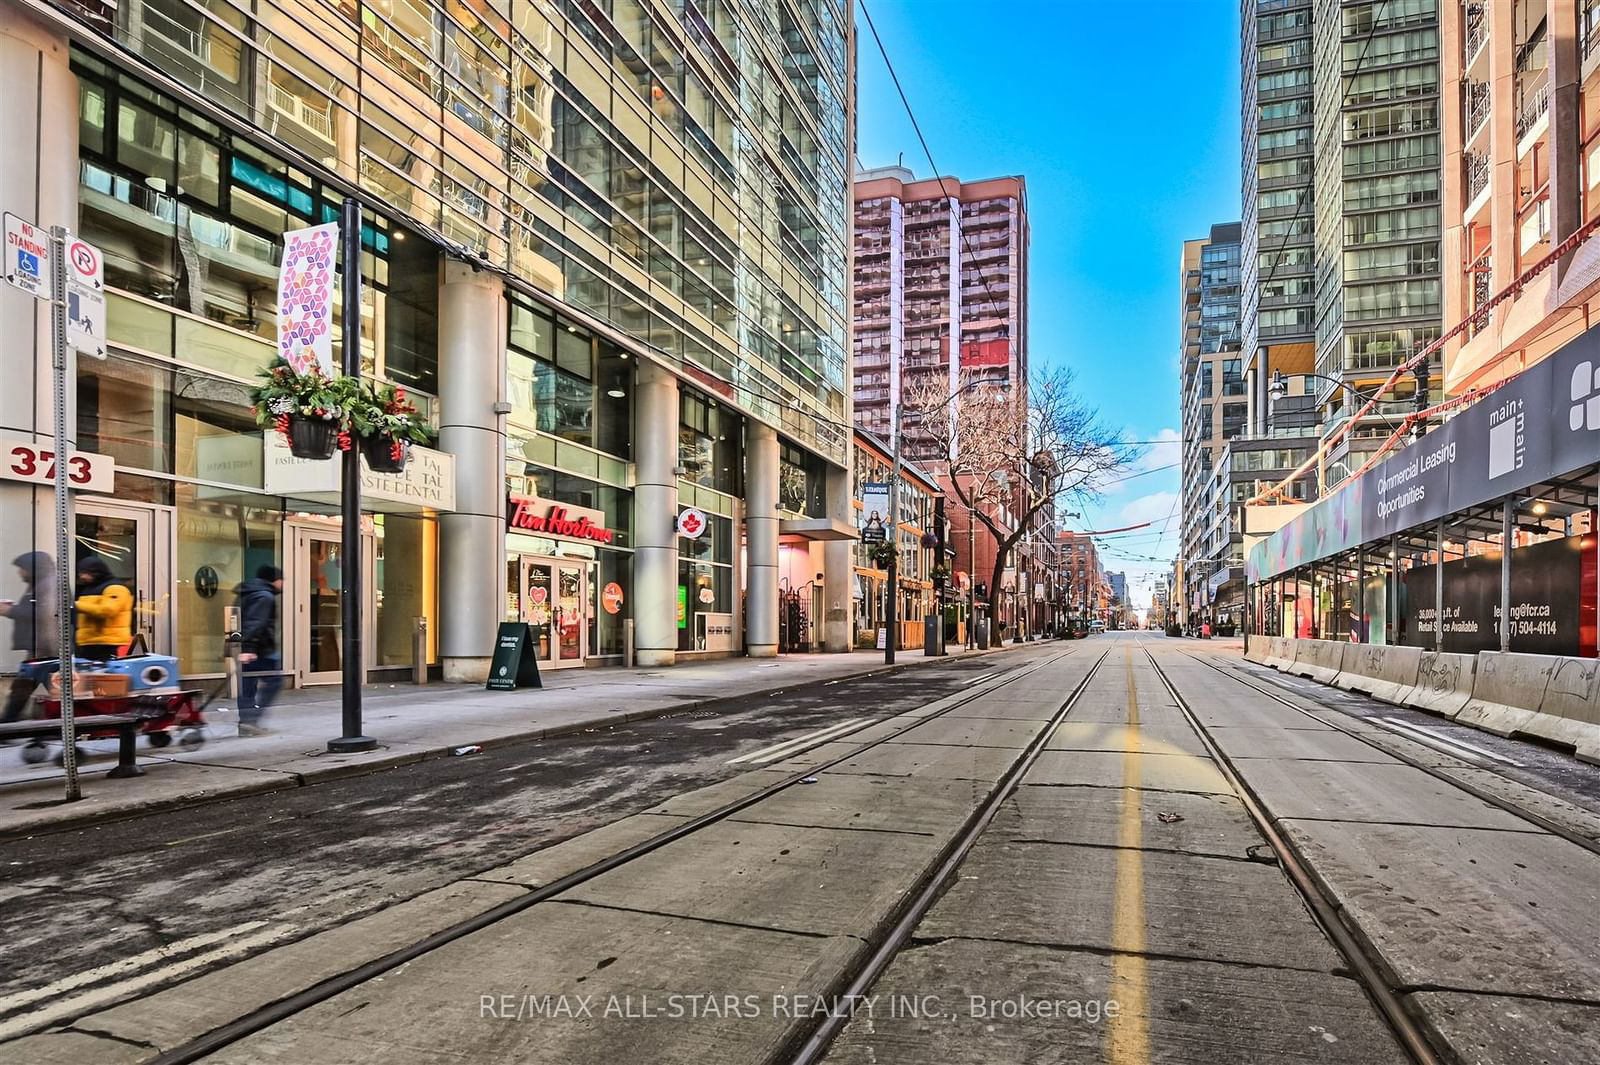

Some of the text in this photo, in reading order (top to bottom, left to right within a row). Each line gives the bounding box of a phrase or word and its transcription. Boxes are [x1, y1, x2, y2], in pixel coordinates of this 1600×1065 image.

[22, 223, 33, 237] NO
[8, 231, 48, 259] STANDING
[20, 279, 36, 291] ZONE
[1515, 412, 1526, 469] main
[11, 447, 92, 484] 373
[1377, 442, 1456, 495] Commercial Leasing
[1377, 485, 1425, 519] Opportunities
[511, 498, 613, 543] Tim Hortons
[1453, 606, 1460, 618] of
[1494, 603, 1550, 620] leng@fcr.ca
[1433, 621, 1450, 632] Sce
[1450, 621, 1478, 632] Available
[1494, 621, 1498, 634] 1
[1519, 620, 1556, 635] 504-4114
